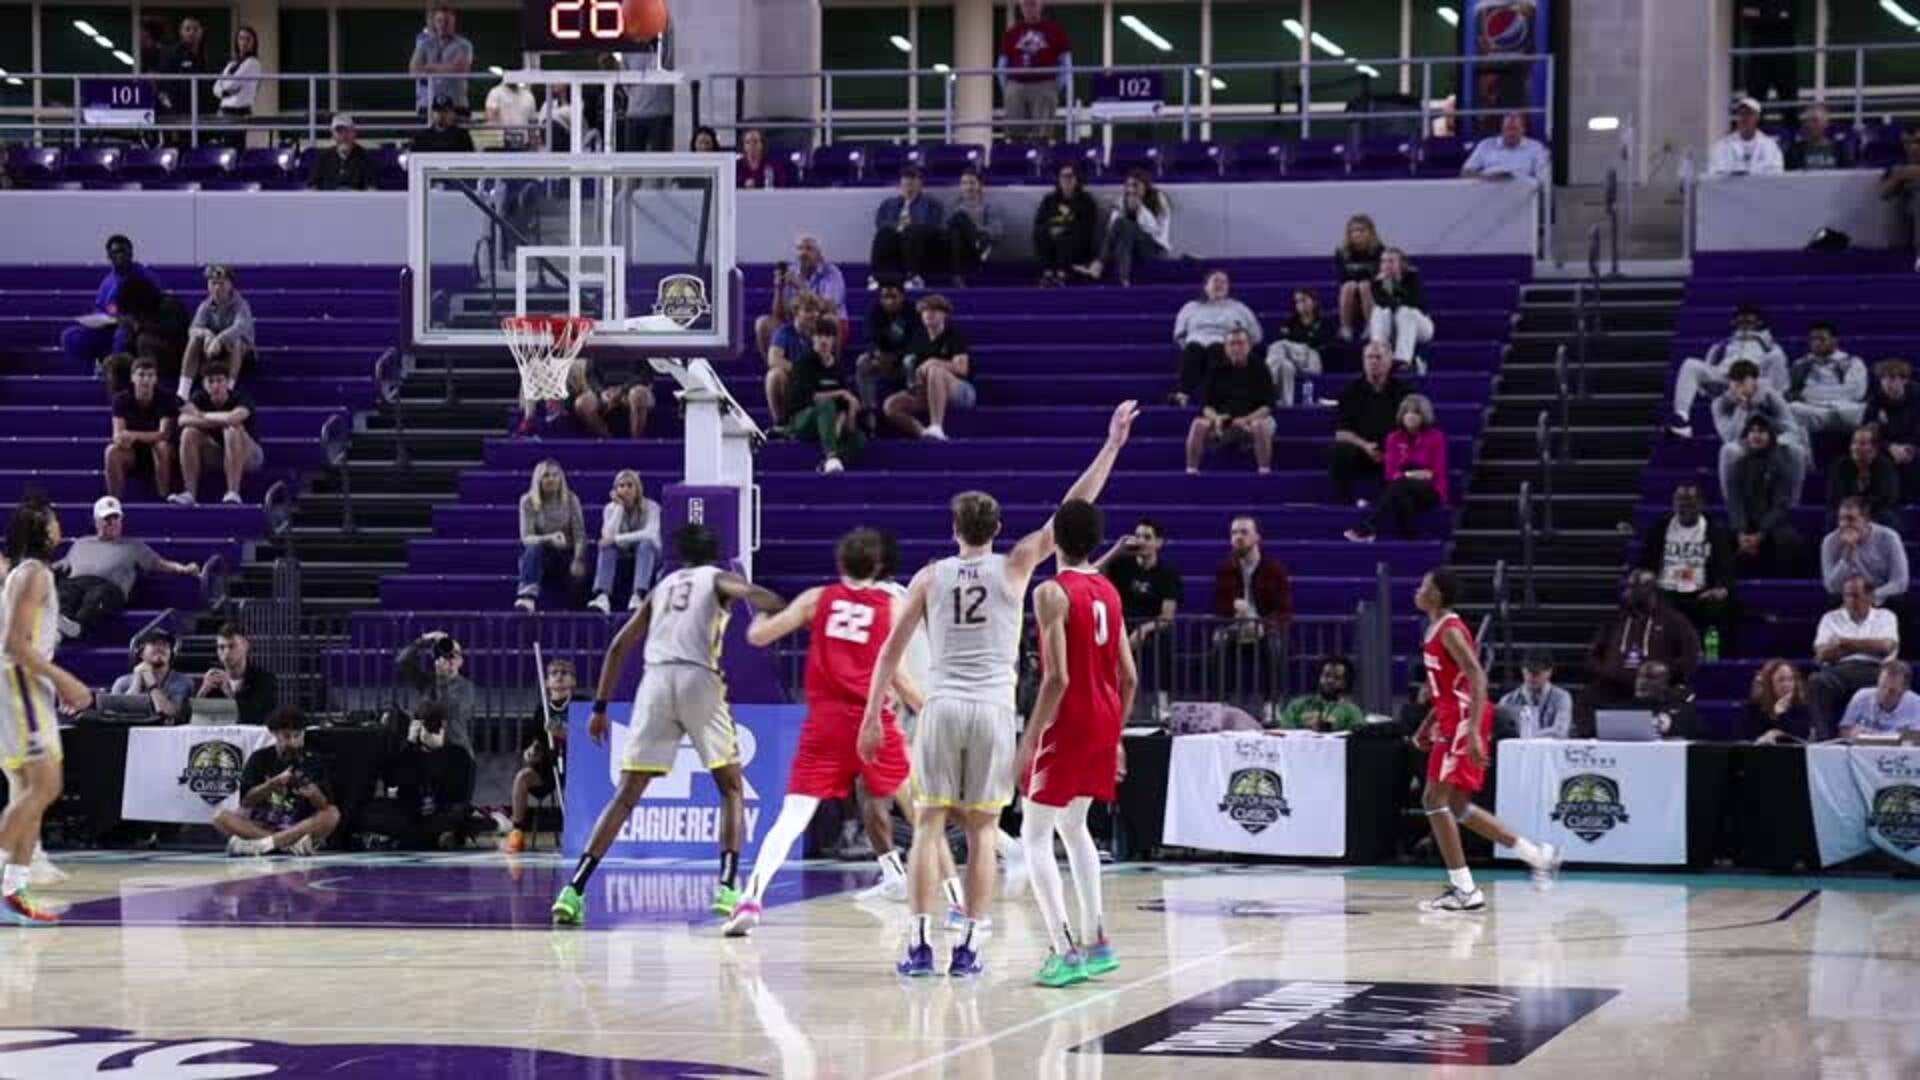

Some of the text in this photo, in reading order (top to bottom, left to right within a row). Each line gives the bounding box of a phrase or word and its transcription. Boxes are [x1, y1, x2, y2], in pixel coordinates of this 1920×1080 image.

[551, 0, 624, 38] 26
[111, 86, 140, 104] 101
[1119, 77, 1151, 96] 102
[665, 581, 693, 612] 13
[952, 585, 988, 624] 12
[825, 599, 875, 645] 22
[1092, 600, 1108, 646] 0
